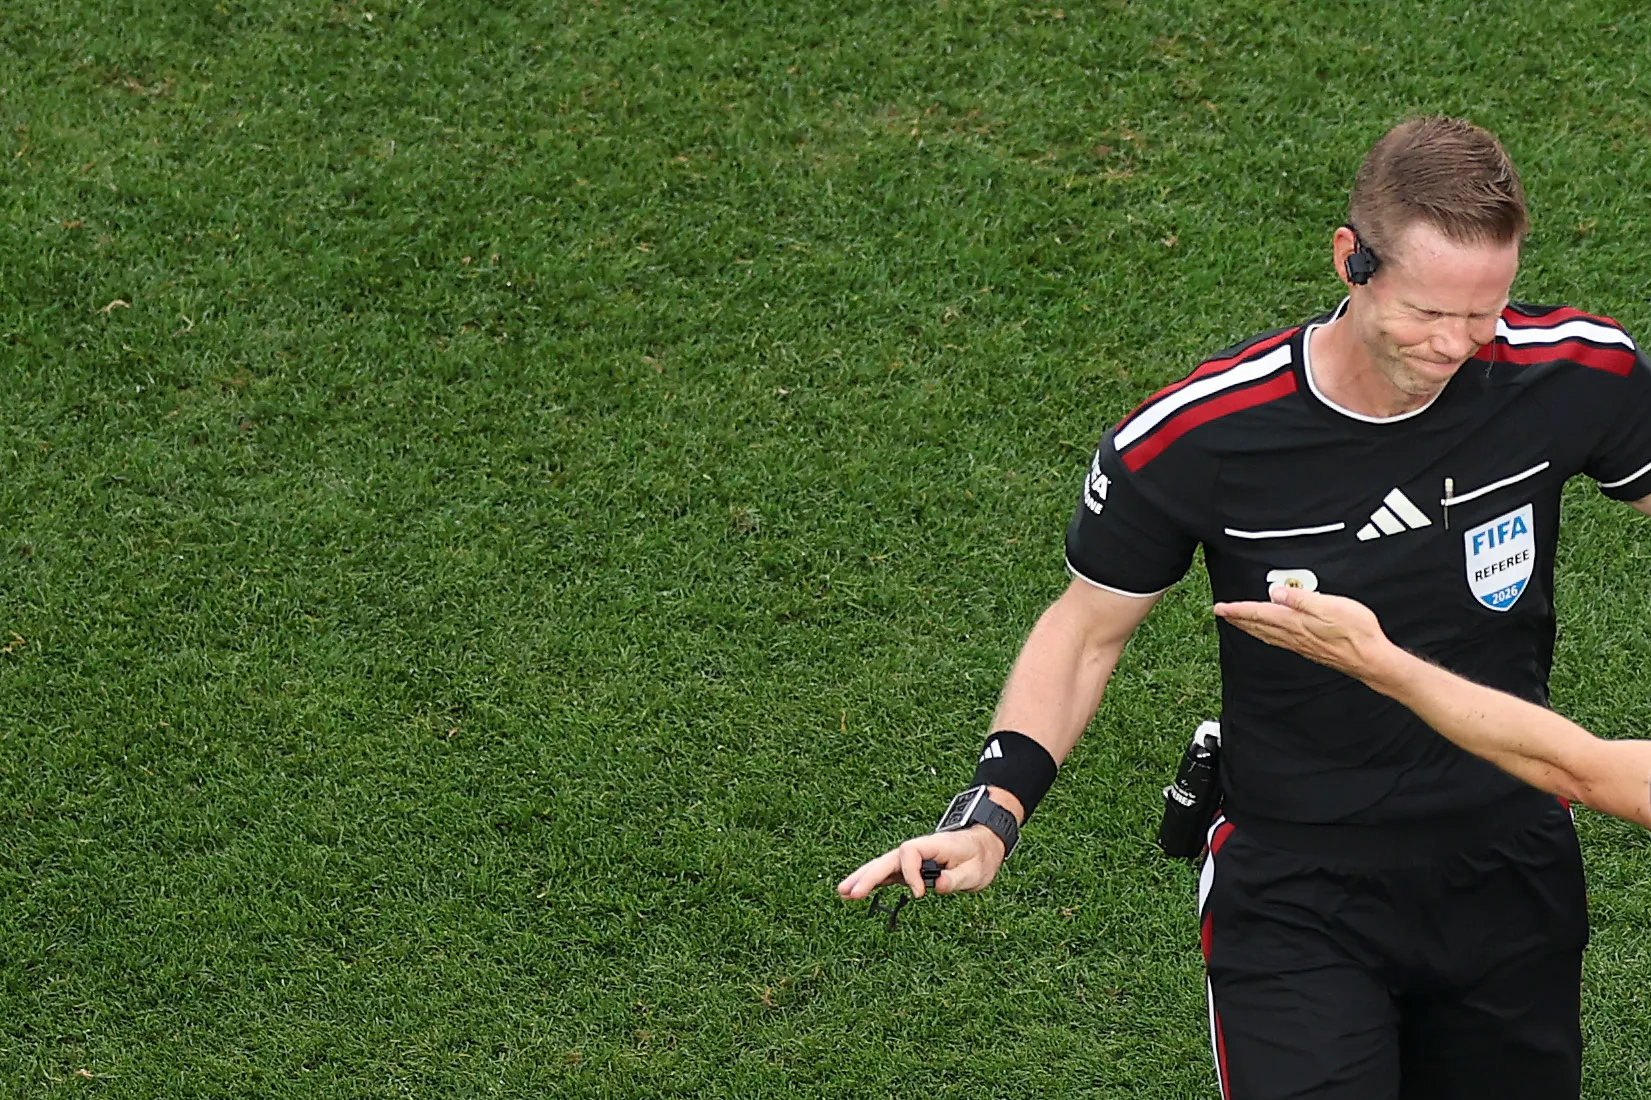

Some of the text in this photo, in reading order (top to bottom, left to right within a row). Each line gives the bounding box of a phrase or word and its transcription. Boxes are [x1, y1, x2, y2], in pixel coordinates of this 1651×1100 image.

[1472, 515, 1528, 556] FIFA
[1475, 549, 1530, 582] REFEREE
[1492, 584, 1518, 605] 2026
